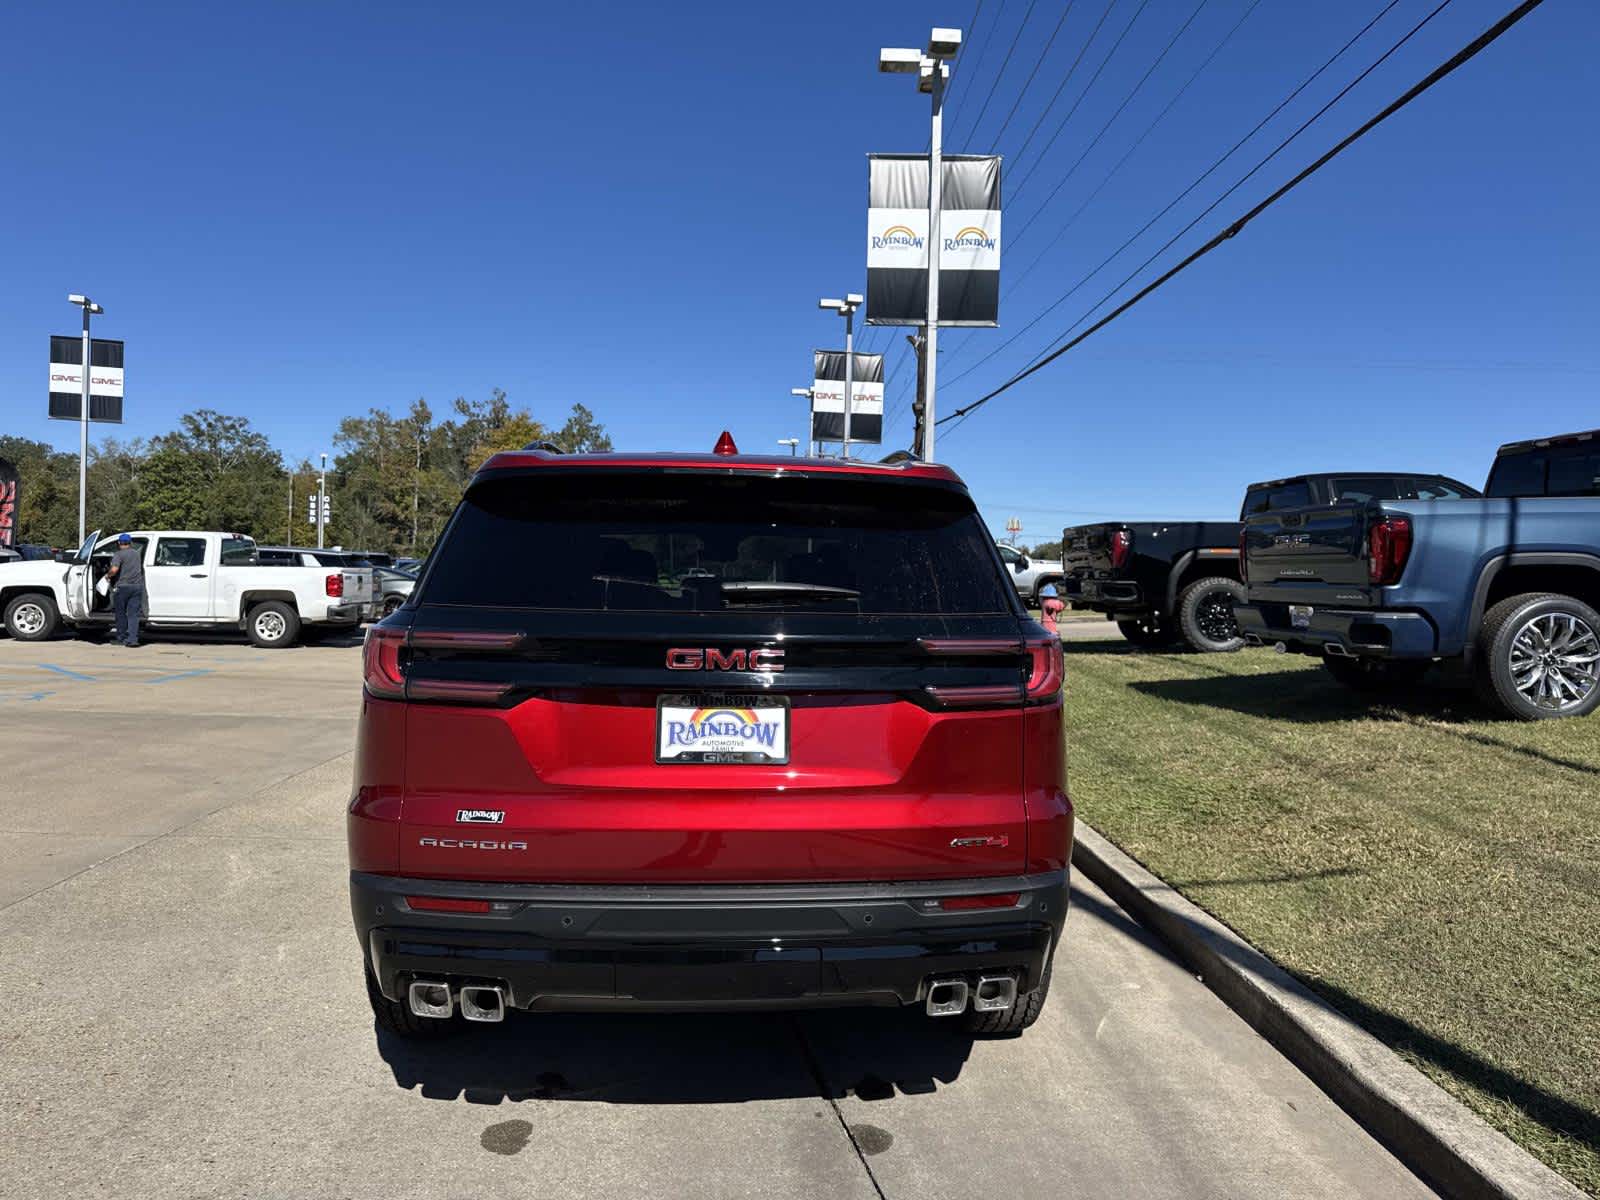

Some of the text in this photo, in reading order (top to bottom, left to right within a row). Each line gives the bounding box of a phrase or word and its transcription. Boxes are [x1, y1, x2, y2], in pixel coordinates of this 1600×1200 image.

[872, 236, 924, 249] RAINBOW
[944, 238, 997, 250] RAINBOW
[51, 374, 82, 383] GMC
[91, 377, 122, 386] GMC
[815, 392, 844, 401] GMC
[853, 394, 882, 402] GMC
[665, 648, 785, 671] GMC
[666, 720, 782, 748] RAINBOW
[703, 752, 744, 763] GMC
[460, 810, 501, 821] RAINBOW
[419, 838, 528, 850] ACADIA
